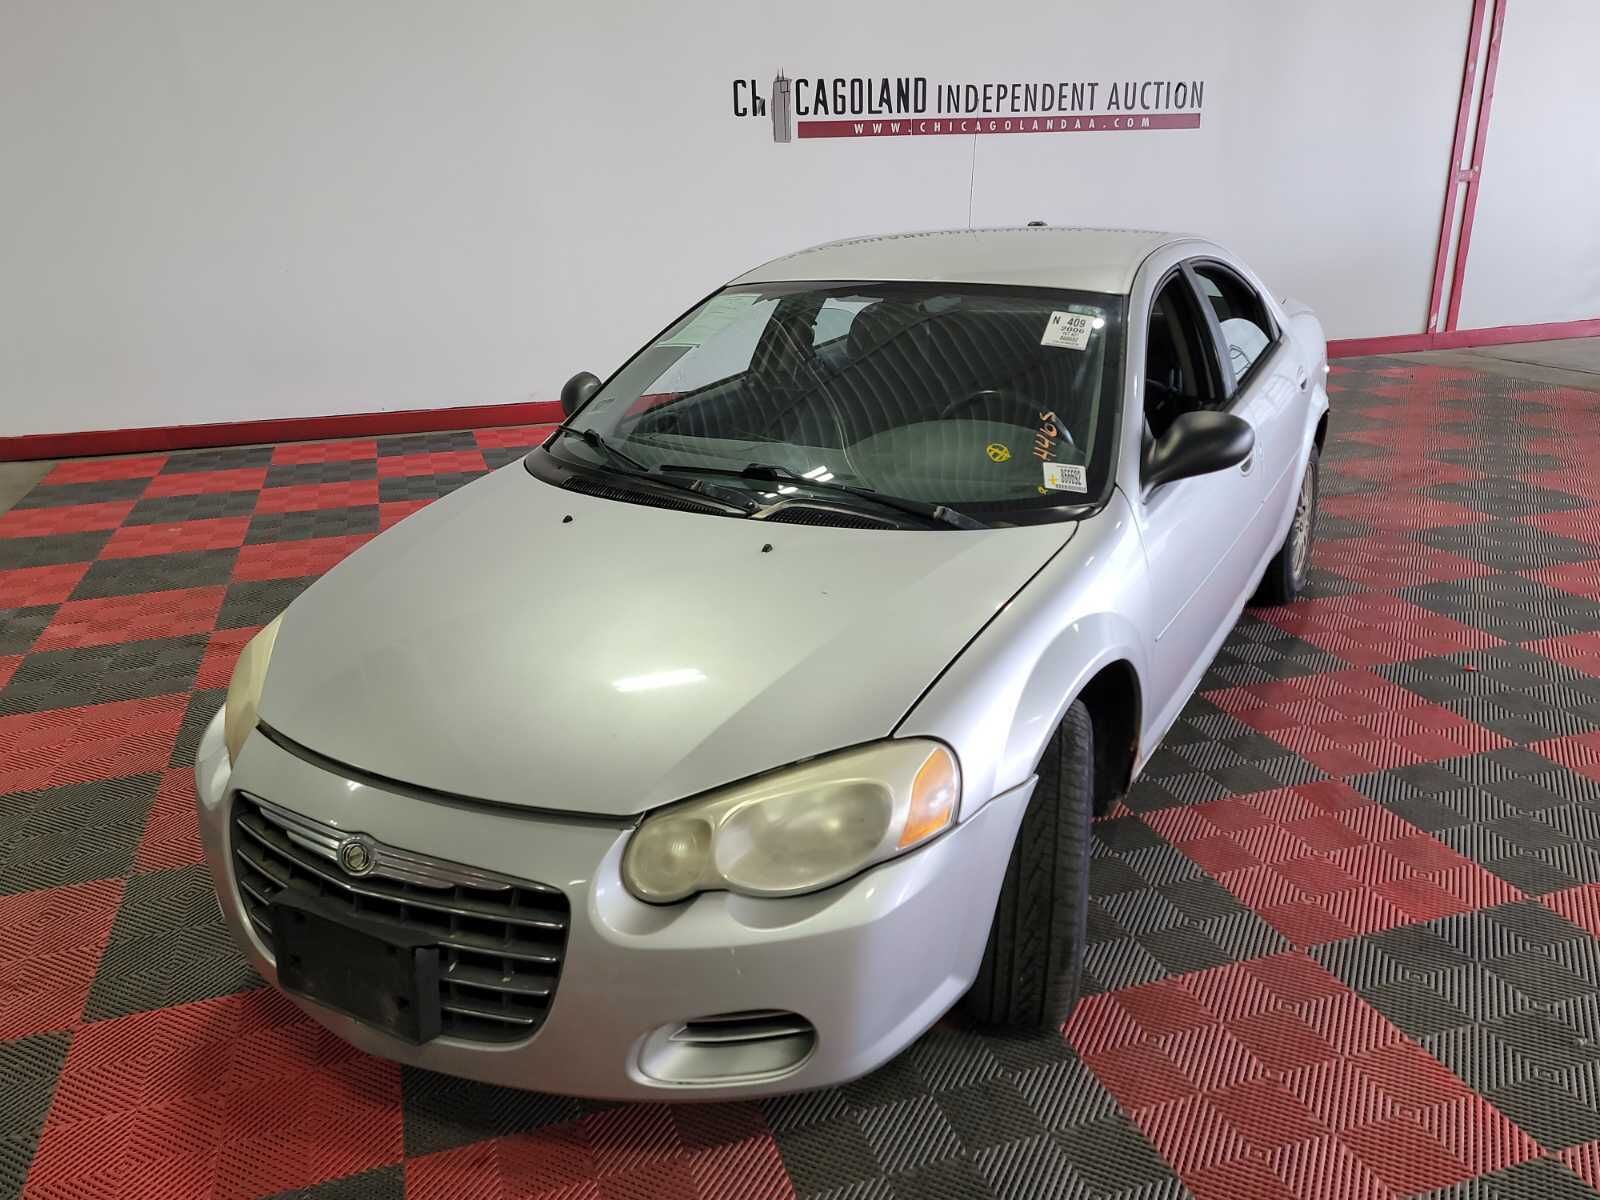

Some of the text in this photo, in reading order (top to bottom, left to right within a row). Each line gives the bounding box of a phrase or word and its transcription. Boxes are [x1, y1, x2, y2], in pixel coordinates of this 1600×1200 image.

[937, 82, 1099, 114] INDEPENDENT
[1106, 80, 1205, 111] AUCTION
[853, 117, 1151, 134] WWW.CHICAGOLANDAA.COM
[1067, 317, 1086, 328] 409
